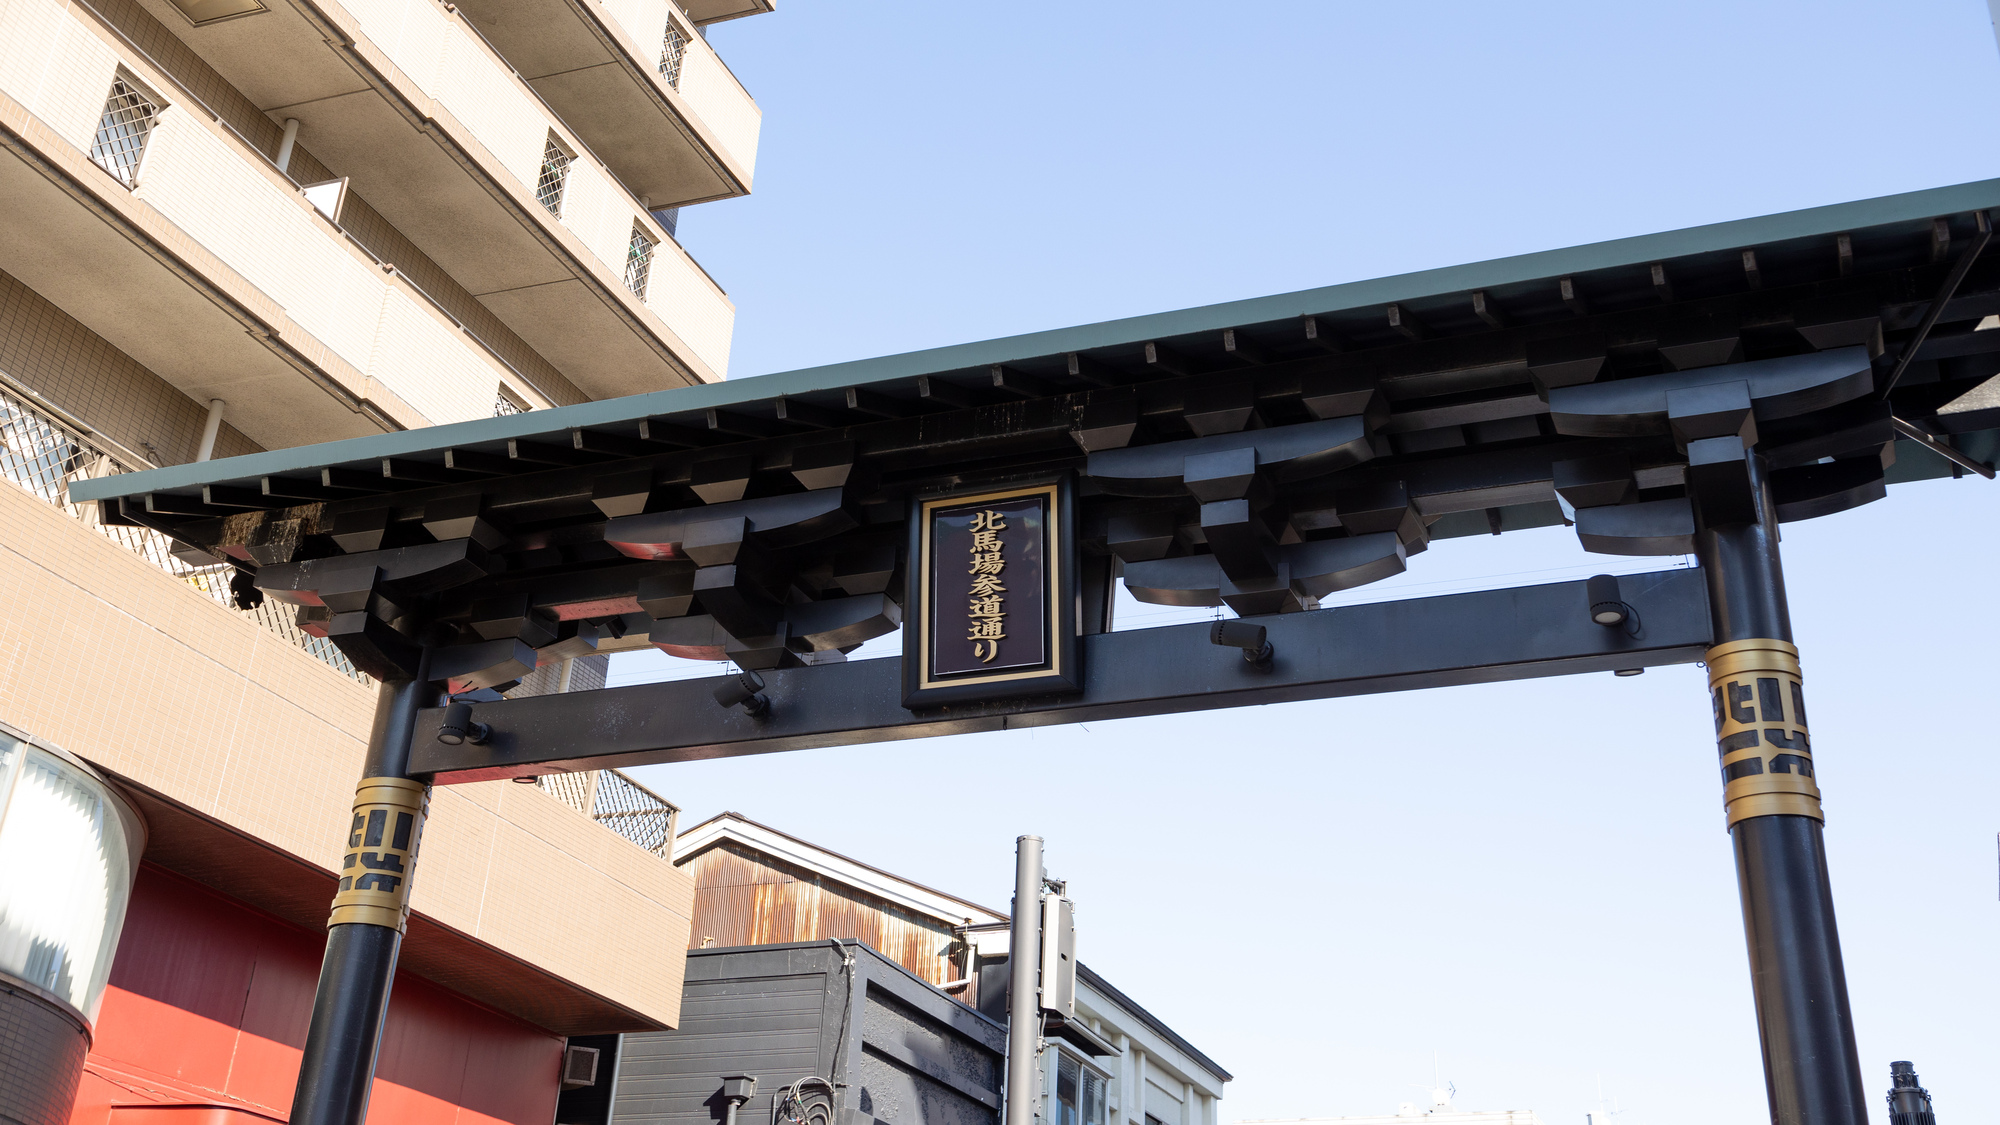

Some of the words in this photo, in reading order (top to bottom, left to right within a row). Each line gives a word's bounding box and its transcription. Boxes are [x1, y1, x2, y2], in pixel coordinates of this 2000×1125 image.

[967, 510, 1007, 663] 北馬場参道通り
